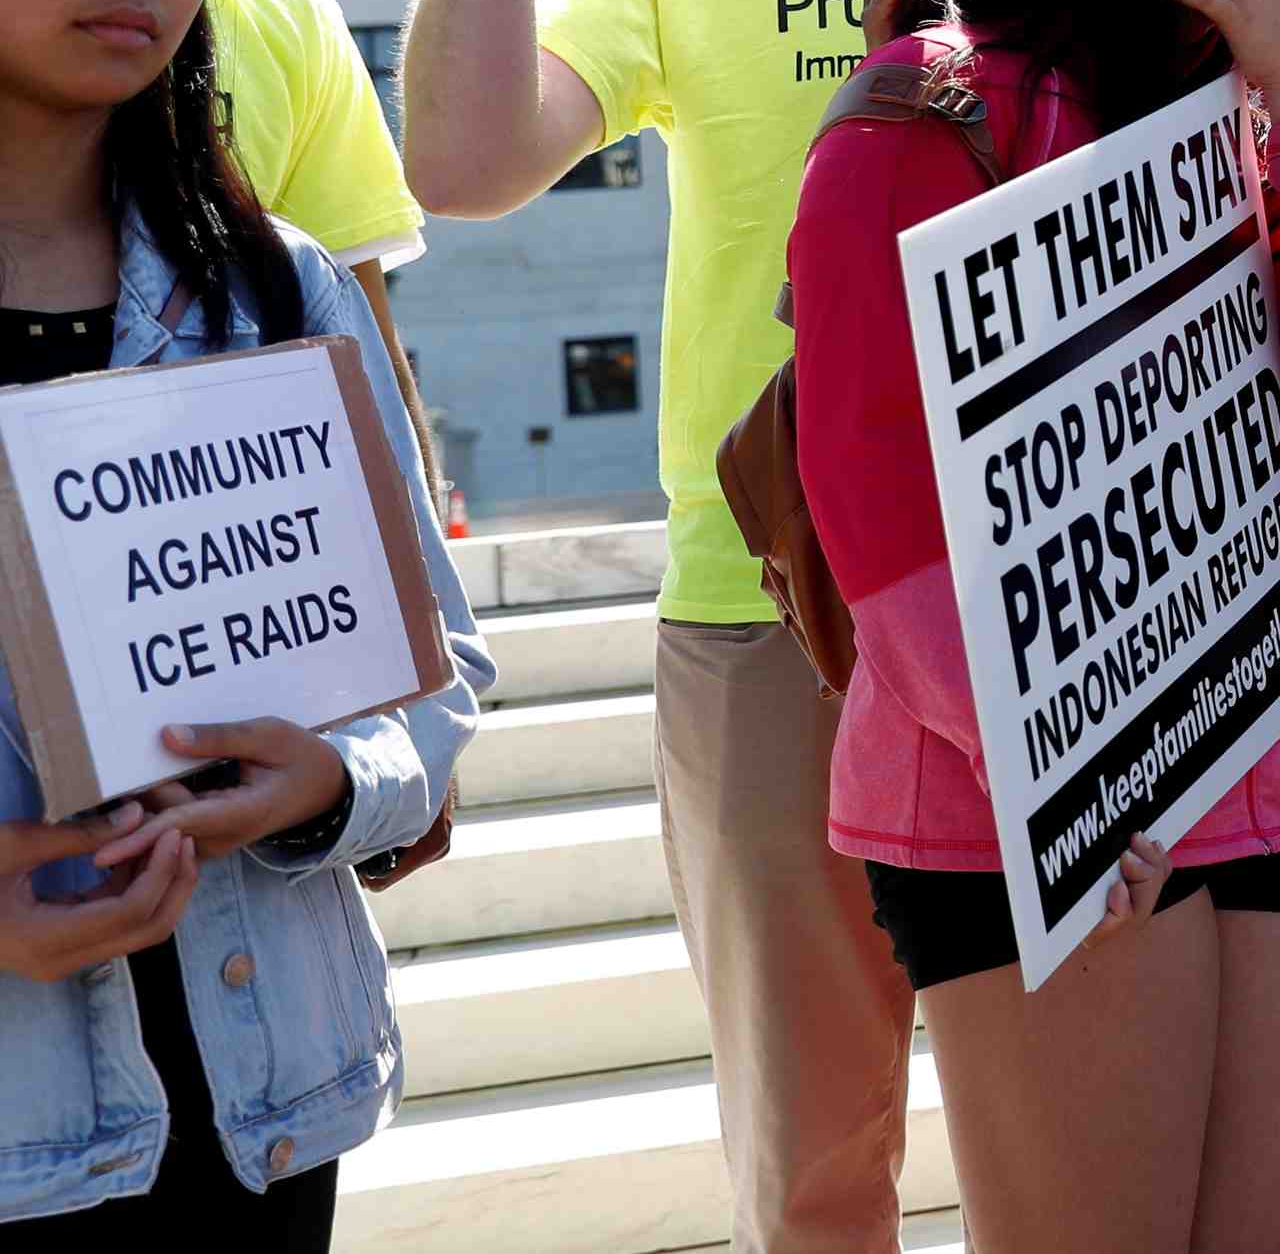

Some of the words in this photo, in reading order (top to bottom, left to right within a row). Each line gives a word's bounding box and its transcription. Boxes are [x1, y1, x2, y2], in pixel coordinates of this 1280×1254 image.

[935, 233, 1025, 384] LET
[1034, 161, 1168, 319] THEM
[1172, 107, 1248, 242] STAY
[54, 422, 332, 521] COMMUNITY
[985, 404, 1086, 546] STOP
[1096, 271, 1269, 465] DEPORTING
[128, 507, 321, 602] AGAINST
[129, 624, 217, 693] ICE
[223, 585, 358, 666] RAIDS
[1024, 573, 1207, 781] INDONESIAN
